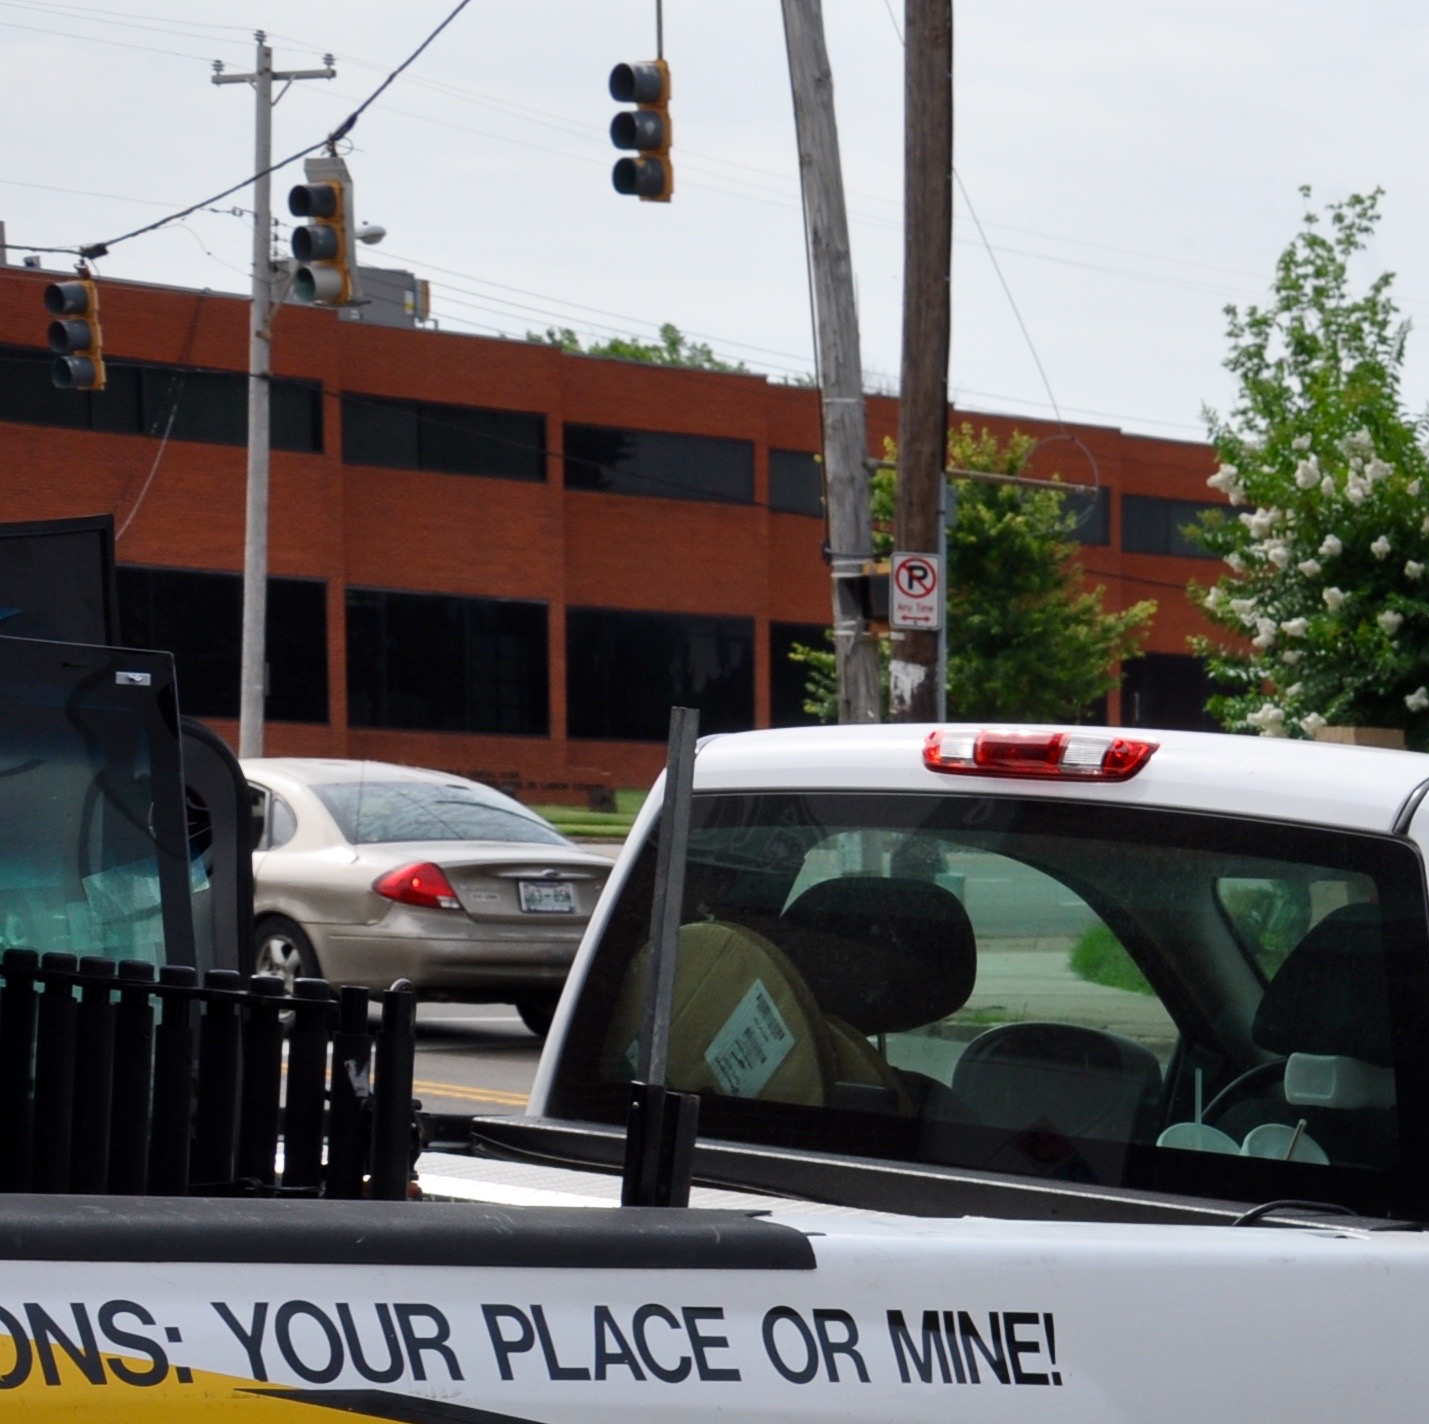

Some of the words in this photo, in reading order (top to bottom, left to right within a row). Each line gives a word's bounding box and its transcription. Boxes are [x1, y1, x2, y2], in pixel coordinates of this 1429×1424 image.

[211, 1300, 465, 1384] YOUR
[480, 1303, 742, 1382] PLACE
[762, 1305, 871, 1384] OR
[886, 1309, 1063, 1386] MINE!
